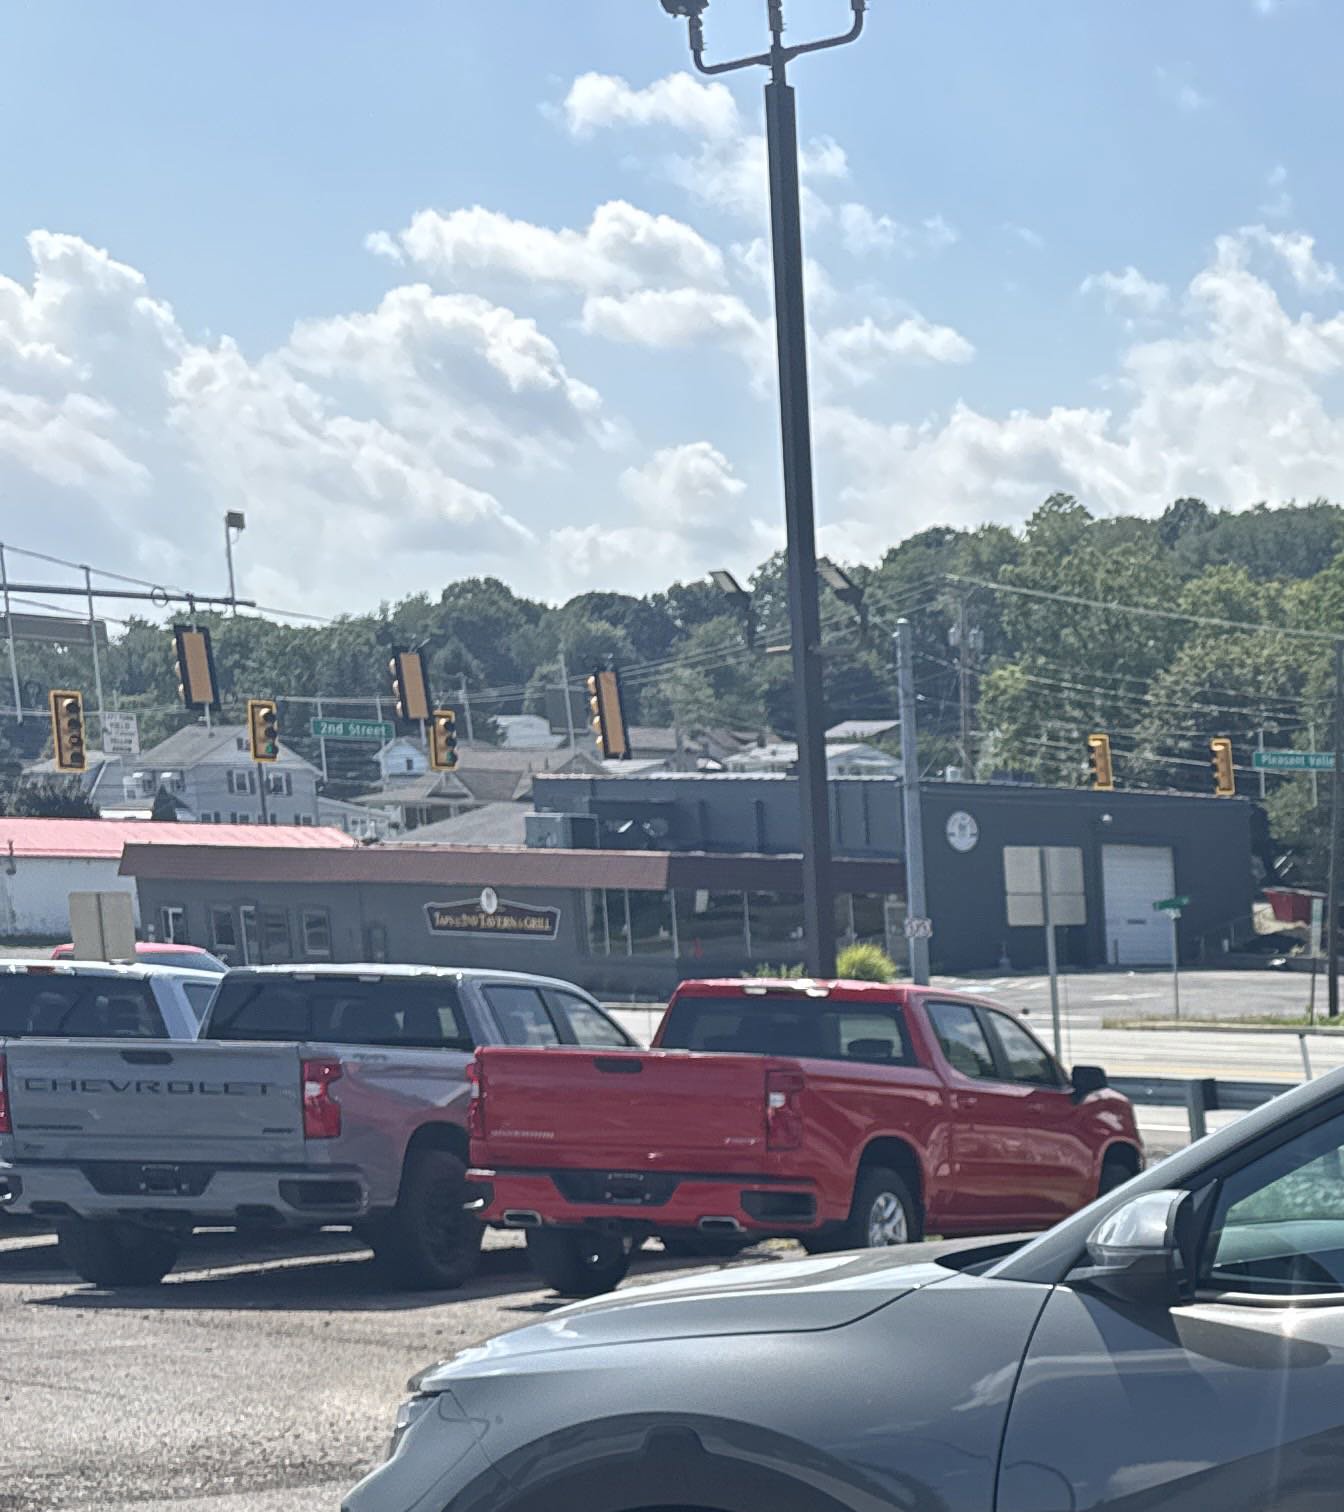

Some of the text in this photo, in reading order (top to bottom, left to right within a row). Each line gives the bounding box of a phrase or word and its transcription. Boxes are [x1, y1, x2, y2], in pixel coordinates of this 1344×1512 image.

[320, 721, 386, 736] 2nd Street
[24, 1077, 276, 1096] CHEVROLET
